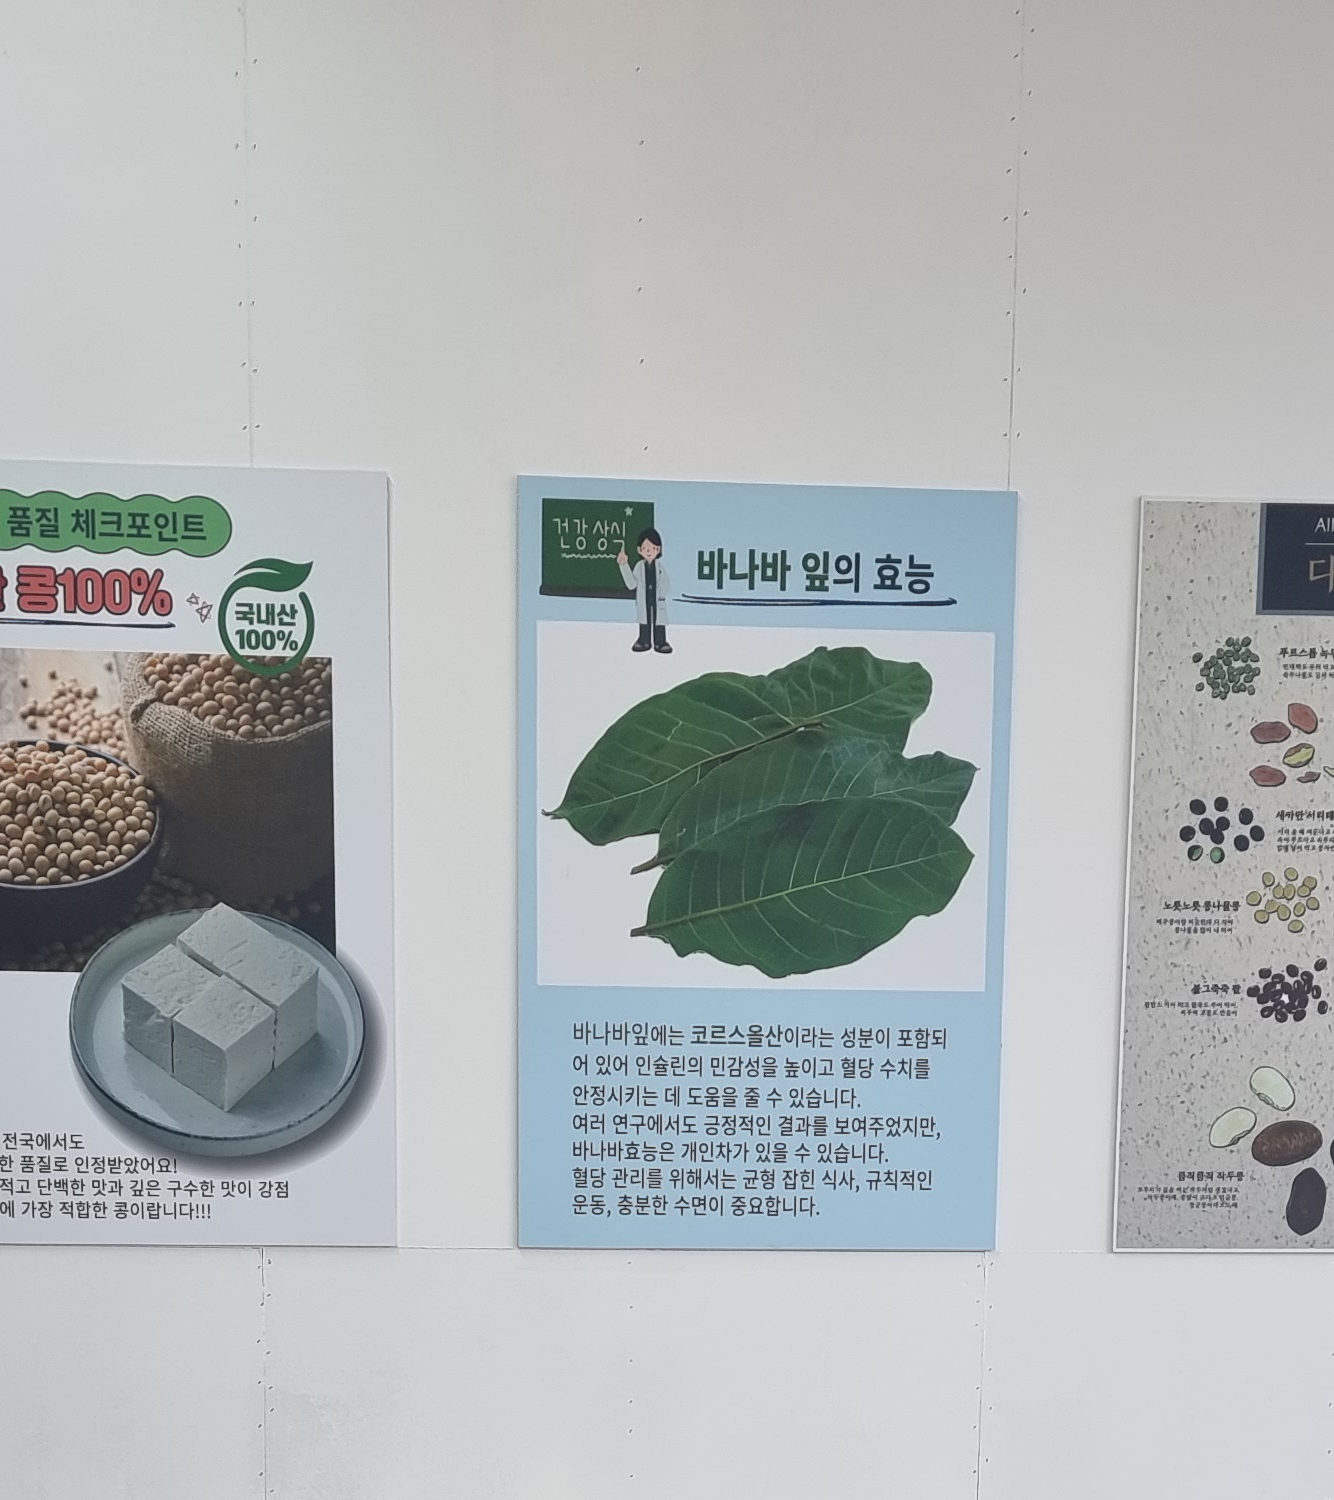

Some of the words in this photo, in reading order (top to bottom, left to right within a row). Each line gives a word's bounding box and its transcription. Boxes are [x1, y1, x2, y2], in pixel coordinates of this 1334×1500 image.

[6, 504, 60, 539] 품질
[70, 507, 208, 542] 체크포인트
[553, 517, 589, 551] 건강
[592, 519, 627, 552] 상식
[697, 547, 791, 592] 바나바
[801, 550, 861, 593] 잎의
[873, 553, 935, 595] 효능
[16, 564, 173, 616] 콩100%
[234, 601, 298, 627] 국내산
[234, 629, 299, 652] 100%
[573, 1020, 685, 1047] 바나바잎에는
[690, 1024, 835, 1049] 코르스올산이라는
[840, 1026, 891, 1050] 성분이
[896, 1027, 947, 1050] 포함되
[572, 1053, 588, 1076] 어
[595, 1054, 628, 1077] 있어
[635, 1054, 703, 1078] 인슐린의
[710, 1055, 778, 1079] 민감성을
[783, 1056, 835, 1079] 높이고
[840, 1056, 875, 1079] 혈당
[879, 1057, 931, 1080] 수치를
[572, 1084, 659, 1107] 안정시키는
[664, 1085, 680, 1108] 데
[686, 1086, 738, 1108] 도움을
[743, 1087, 761, 1109] 줄
[765, 1087, 783, 1109] 수
[788, 1086, 861, 1110] 있습니다.
[572, 1112, 605, 1135] 여러
[612, 1113, 699, 1136] 연구에서도
[703, 1114, 771, 1137] 긍정적인
[778, 1115, 829, 1137] 결과를
[833, 1115, 941, 1141] 보여주었지만,
[2, 1131, 85, 1152] 전국에서도
[572, 1139, 676, 1163] 바나바효능은
[681, 1141, 750, 1164] 개인차가
[755, 1141, 789, 1164] 있을
[794, 1142, 811, 1164] 수
[817, 1142, 889, 1165] 있습니다.
[19, 1154, 69, 1174] 품질로
[74, 1155, 177, 1175] 인정받았어요!
[37, 1177, 86, 1197] 단백한
[91, 1178, 124, 1197] 맛과
[129, 1178, 162, 1197] 깊은
[166, 1180, 216, 1198] 구수한
[221, 1180, 252, 1199] 맛이
[258, 1180, 289, 1199] 강점
[572, 1166, 607, 1189] 혈당
[611, 1167, 664, 1190] 관리를
[668, 1167, 737, 1191] 위해서는
[742, 1168, 775, 1190] 균형
[781, 1168, 815, 1191] 잡힌
[821, 1169, 860, 1193] 식사,
[865, 1169, 932, 1192] 규칙적인
[21, 1200, 54, 1219] 가장
[58, 1200, 109, 1219] 적합한
[113, 1201, 211, 1221] 콩이랍니다!!!
[571, 1194, 611, 1218] 운동,
[617, 1194, 669, 1216] 충분한
[673, 1194, 724, 1217] 수면이
[730, 1195, 820, 1218] 중요합니다.
